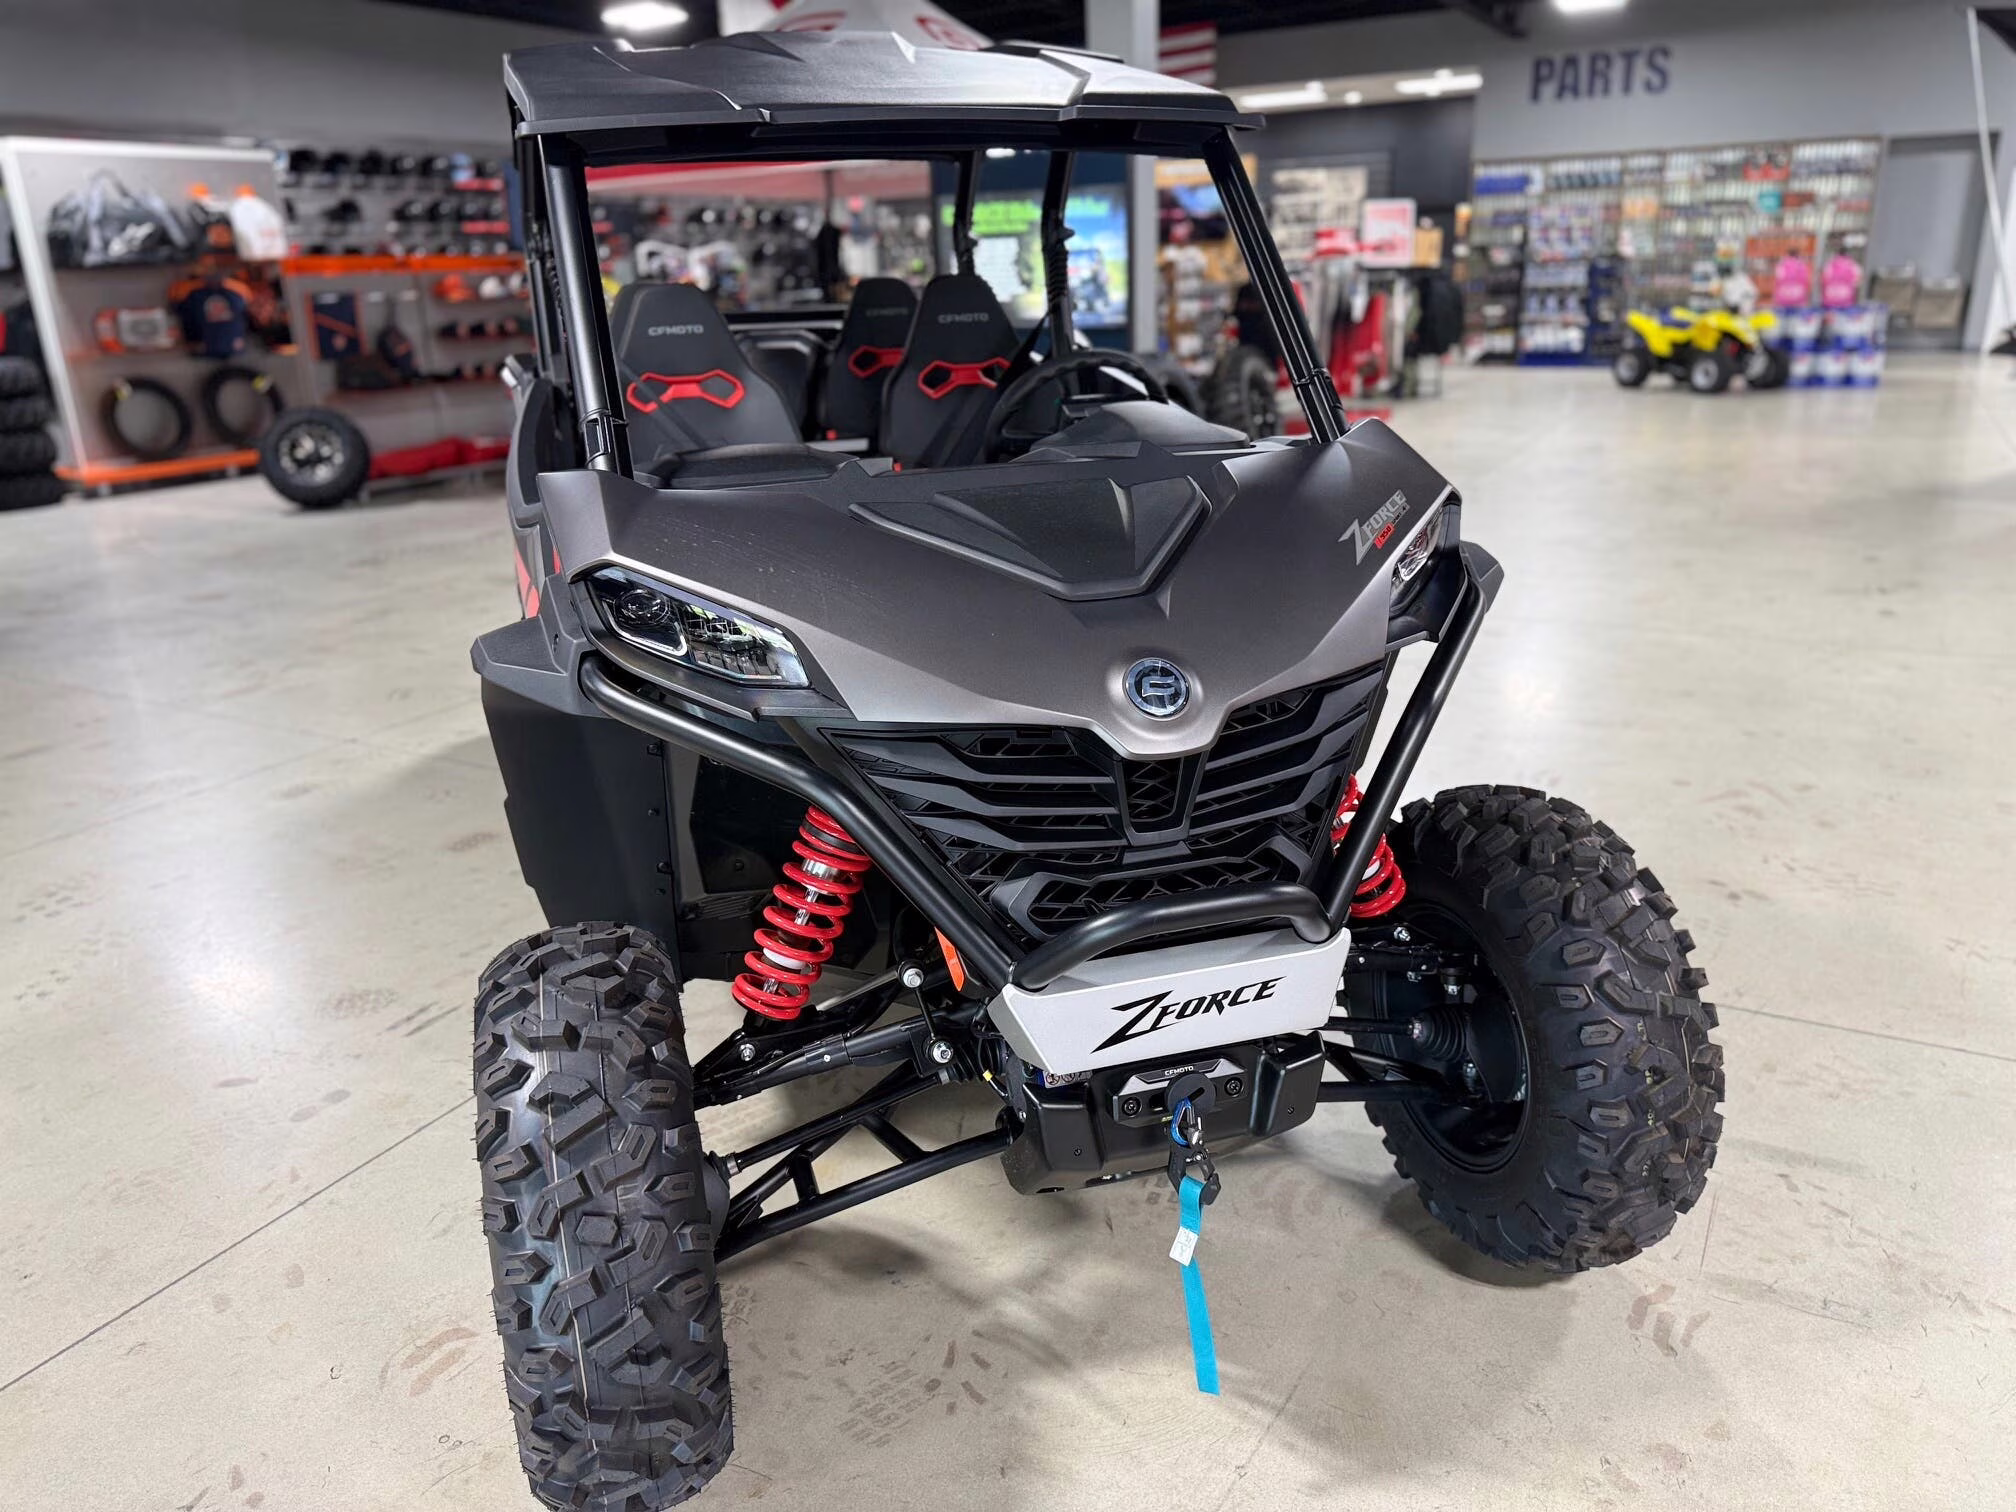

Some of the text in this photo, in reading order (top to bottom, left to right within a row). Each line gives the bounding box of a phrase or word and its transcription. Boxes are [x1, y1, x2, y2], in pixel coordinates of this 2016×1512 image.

[1530, 45, 1672, 102] PARTS
[938, 312, 989, 324] CFMOTO
[648, 324, 704, 336] CFMOTO
[1090, 976, 1287, 1055] ZFORCE
[1164, 1064, 1194, 1077] CFMOTO
